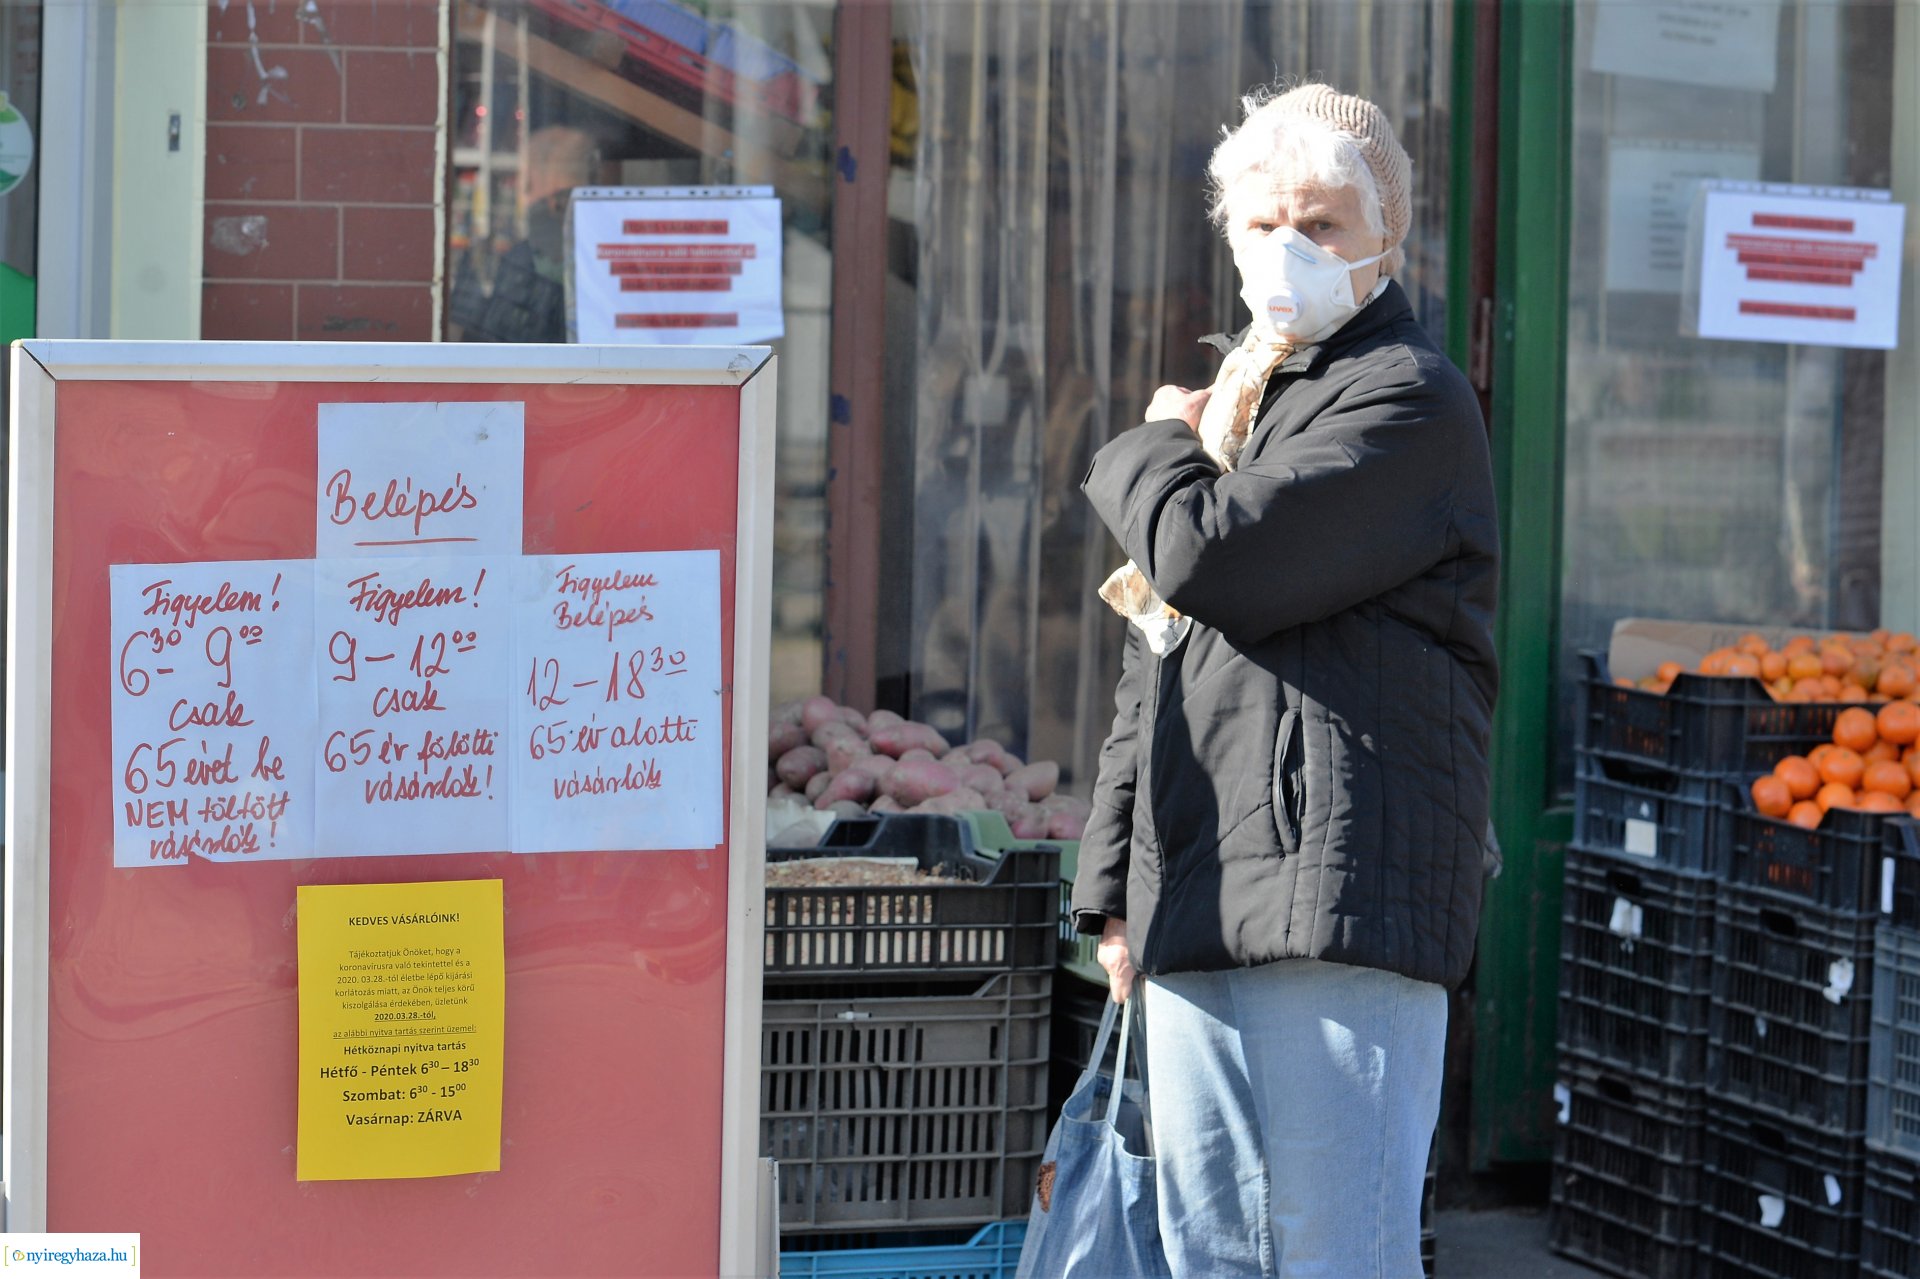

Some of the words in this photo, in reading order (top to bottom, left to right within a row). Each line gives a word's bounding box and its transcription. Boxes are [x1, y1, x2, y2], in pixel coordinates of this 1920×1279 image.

[326, 469, 478, 536] Belépés
[555, 565, 660, 606] Figyelem
[553, 595, 654, 642] Belépés
[529, 720, 568, 761] 65
[324, 729, 376, 773] 65
[124, 737, 187, 795] 65
[250, 735, 286, 782] be
[553, 757, 662, 800] vásárlók
[124, 798, 189, 829] NEM
[197, 790, 291, 824] töltött
[349, 916, 389, 926] KEDVES
[391, 912, 460, 925] VÁSÁRLÓINK!
[349, 949, 401, 960] Tájékoztatjuk
[435, 947, 454, 957] hogy
[395, 960, 412, 969] való
[413, 959, 454, 968] tekintettel
[455, 958, 464, 967] és
[400, 973, 425, 982] életbe
[335, 988, 376, 997] korlátozás
[412, 984, 433, 994] Önök
[434, 984, 456, 994] teljes
[342, 999, 388, 1010] kiszolgálása
[435, 997, 468, 1006] üzletünk
[343, 1029, 368, 1038] alábbi
[369, 1028, 393, 1038] nyitva
[395, 1026, 418, 1036] tartás
[419, 1026, 445, 1035] szerint
[344, 1043, 401, 1055] Hétköznapi
[403, 1042, 434, 1054] nyitva
[437, 1040, 466, 1051] tartás
[320, 1065, 358, 1078] Hétfő
[371, 1062, 418, 1076] Péntek
[342, 1087, 406, 1102] Szombat:
[346, 1112, 414, 1127] Vasárnap:
[417, 1107, 463, 1123] ZÁRVA
